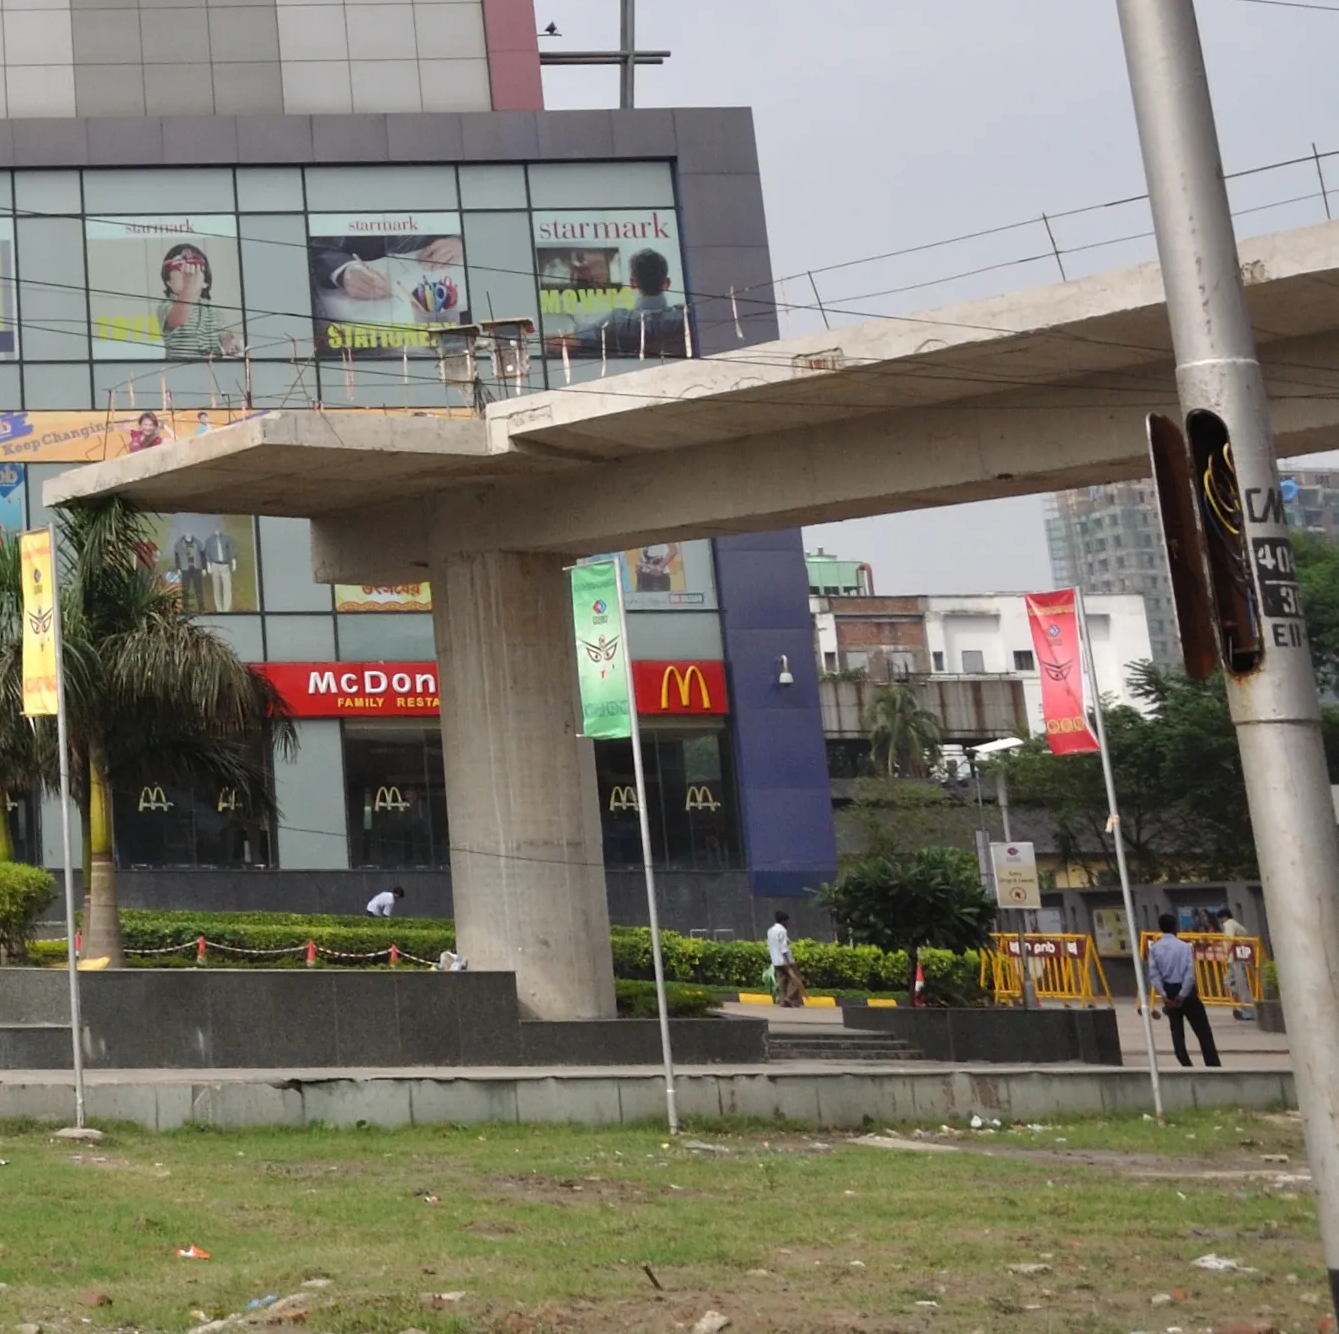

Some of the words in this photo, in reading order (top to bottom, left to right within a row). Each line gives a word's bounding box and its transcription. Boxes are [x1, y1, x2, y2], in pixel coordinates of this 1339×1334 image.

[125, 218, 196, 235] starmark
[348, 215, 419, 232] starmark
[539, 210, 671, 240] starmark
[539, 287, 636, 315] MOVIES
[337, 697, 385, 707] FAMILY
